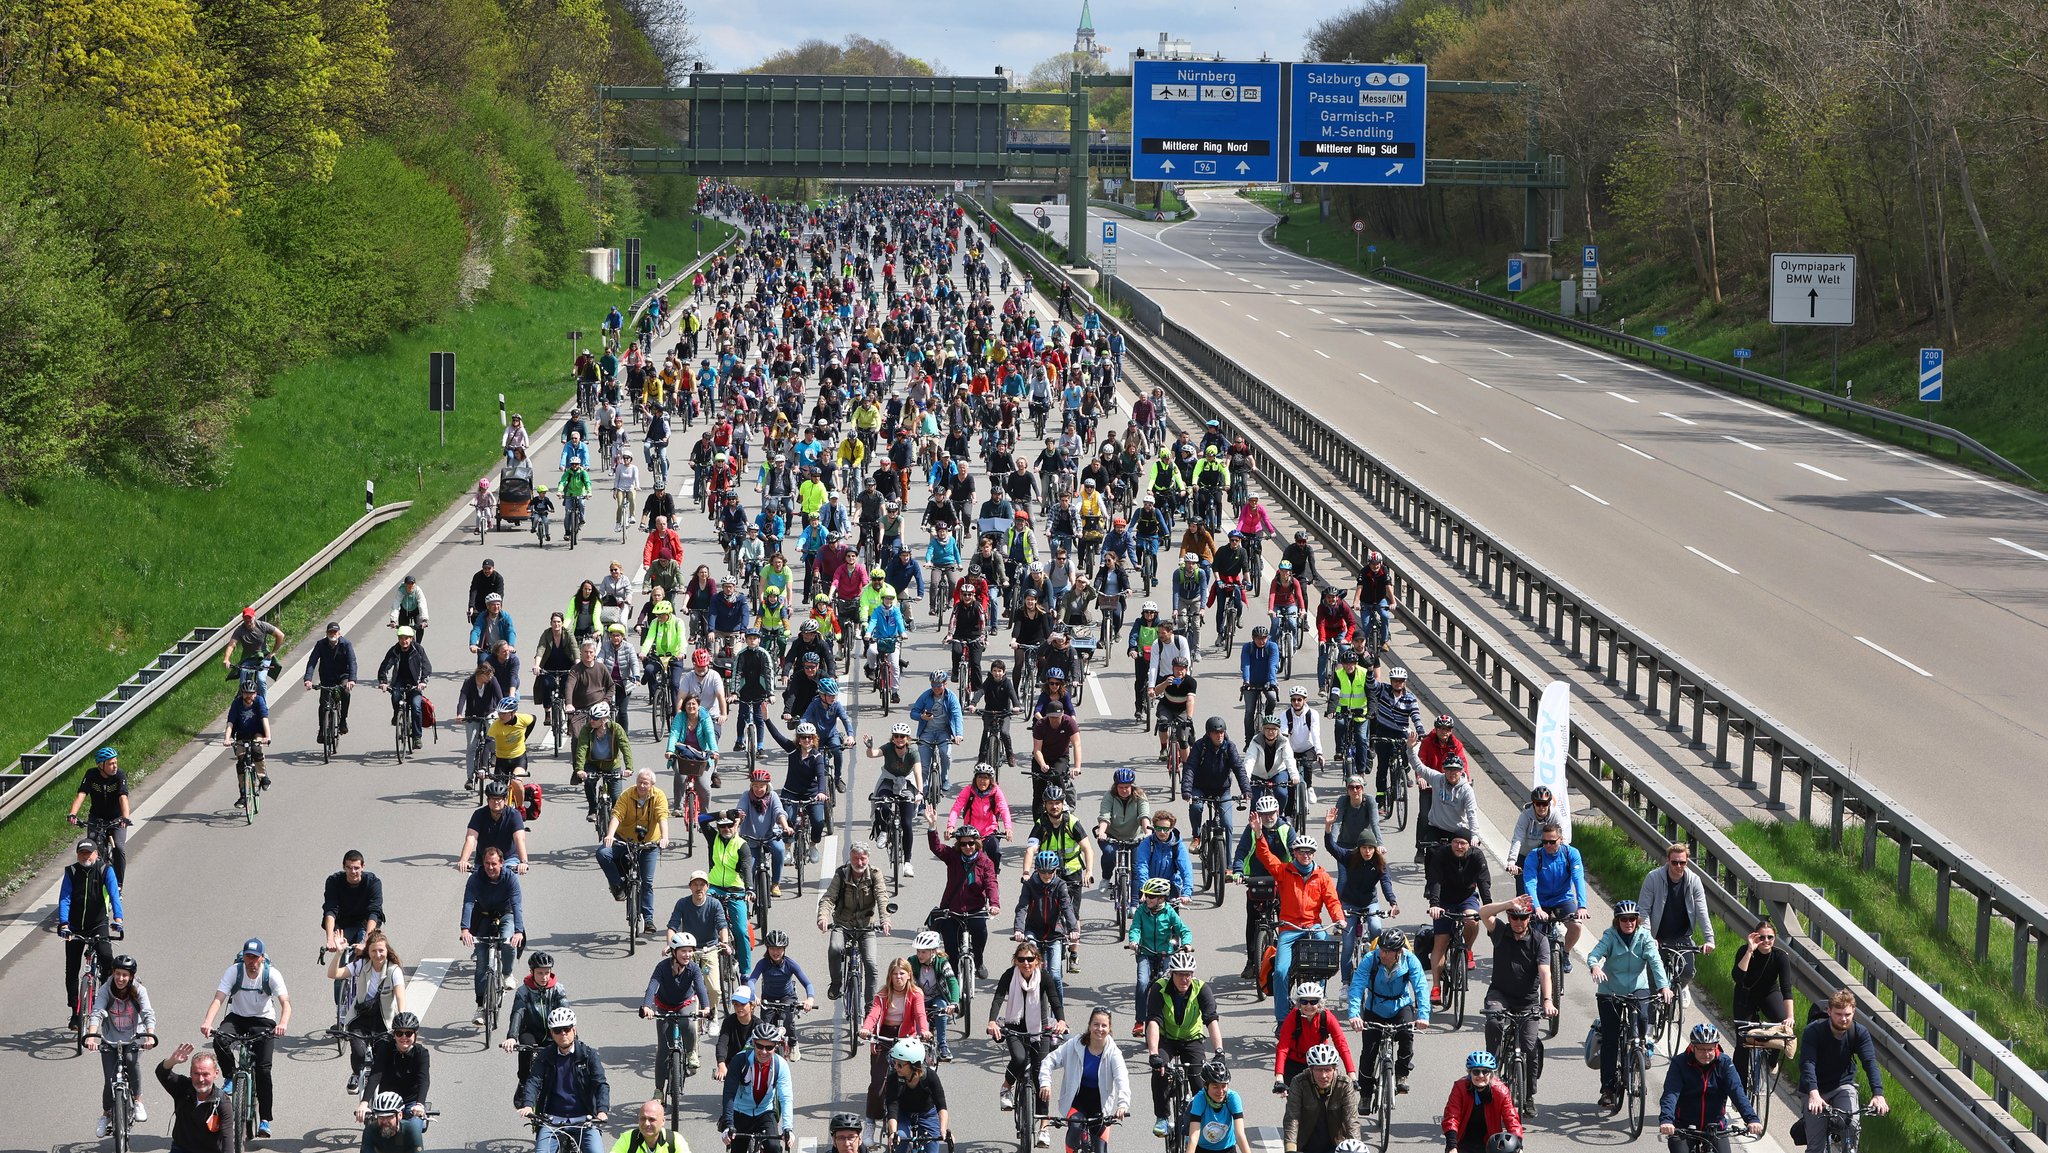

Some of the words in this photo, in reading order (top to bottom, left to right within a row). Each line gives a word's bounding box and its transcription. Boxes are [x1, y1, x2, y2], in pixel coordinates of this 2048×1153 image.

[1177, 69, 1236, 85] Nürnberg
[1307, 72, 1361, 87] Salzburg
[1372, 75, 1380, 83] A
[1178, 89, 1190, 98] M.
[1204, 89, 1216, 98] M.
[1309, 91, 1354, 104] Passau
[1362, 94, 1404, 104] Messe/ICM
[1320, 110, 1395, 123] Garmisch-P.
[1321, 125, 1394, 141] M.-Sendling
[1162, 140, 1199, 151] Mittlerer
[1203, 141, 1223, 154] Ring
[1227, 142, 1249, 152] Nord
[1315, 143, 1353, 154] Mittlerer
[1357, 144, 1376, 156] Ring
[1380, 144, 1398, 155] Süd
[1199, 162, 1211, 172] 96
[1780, 260, 1846, 273] Olympiapark
[1786, 273, 1813, 284] BMW
[1817, 274, 1841, 285] Welt
[1924, 351, 1939, 360] 200
